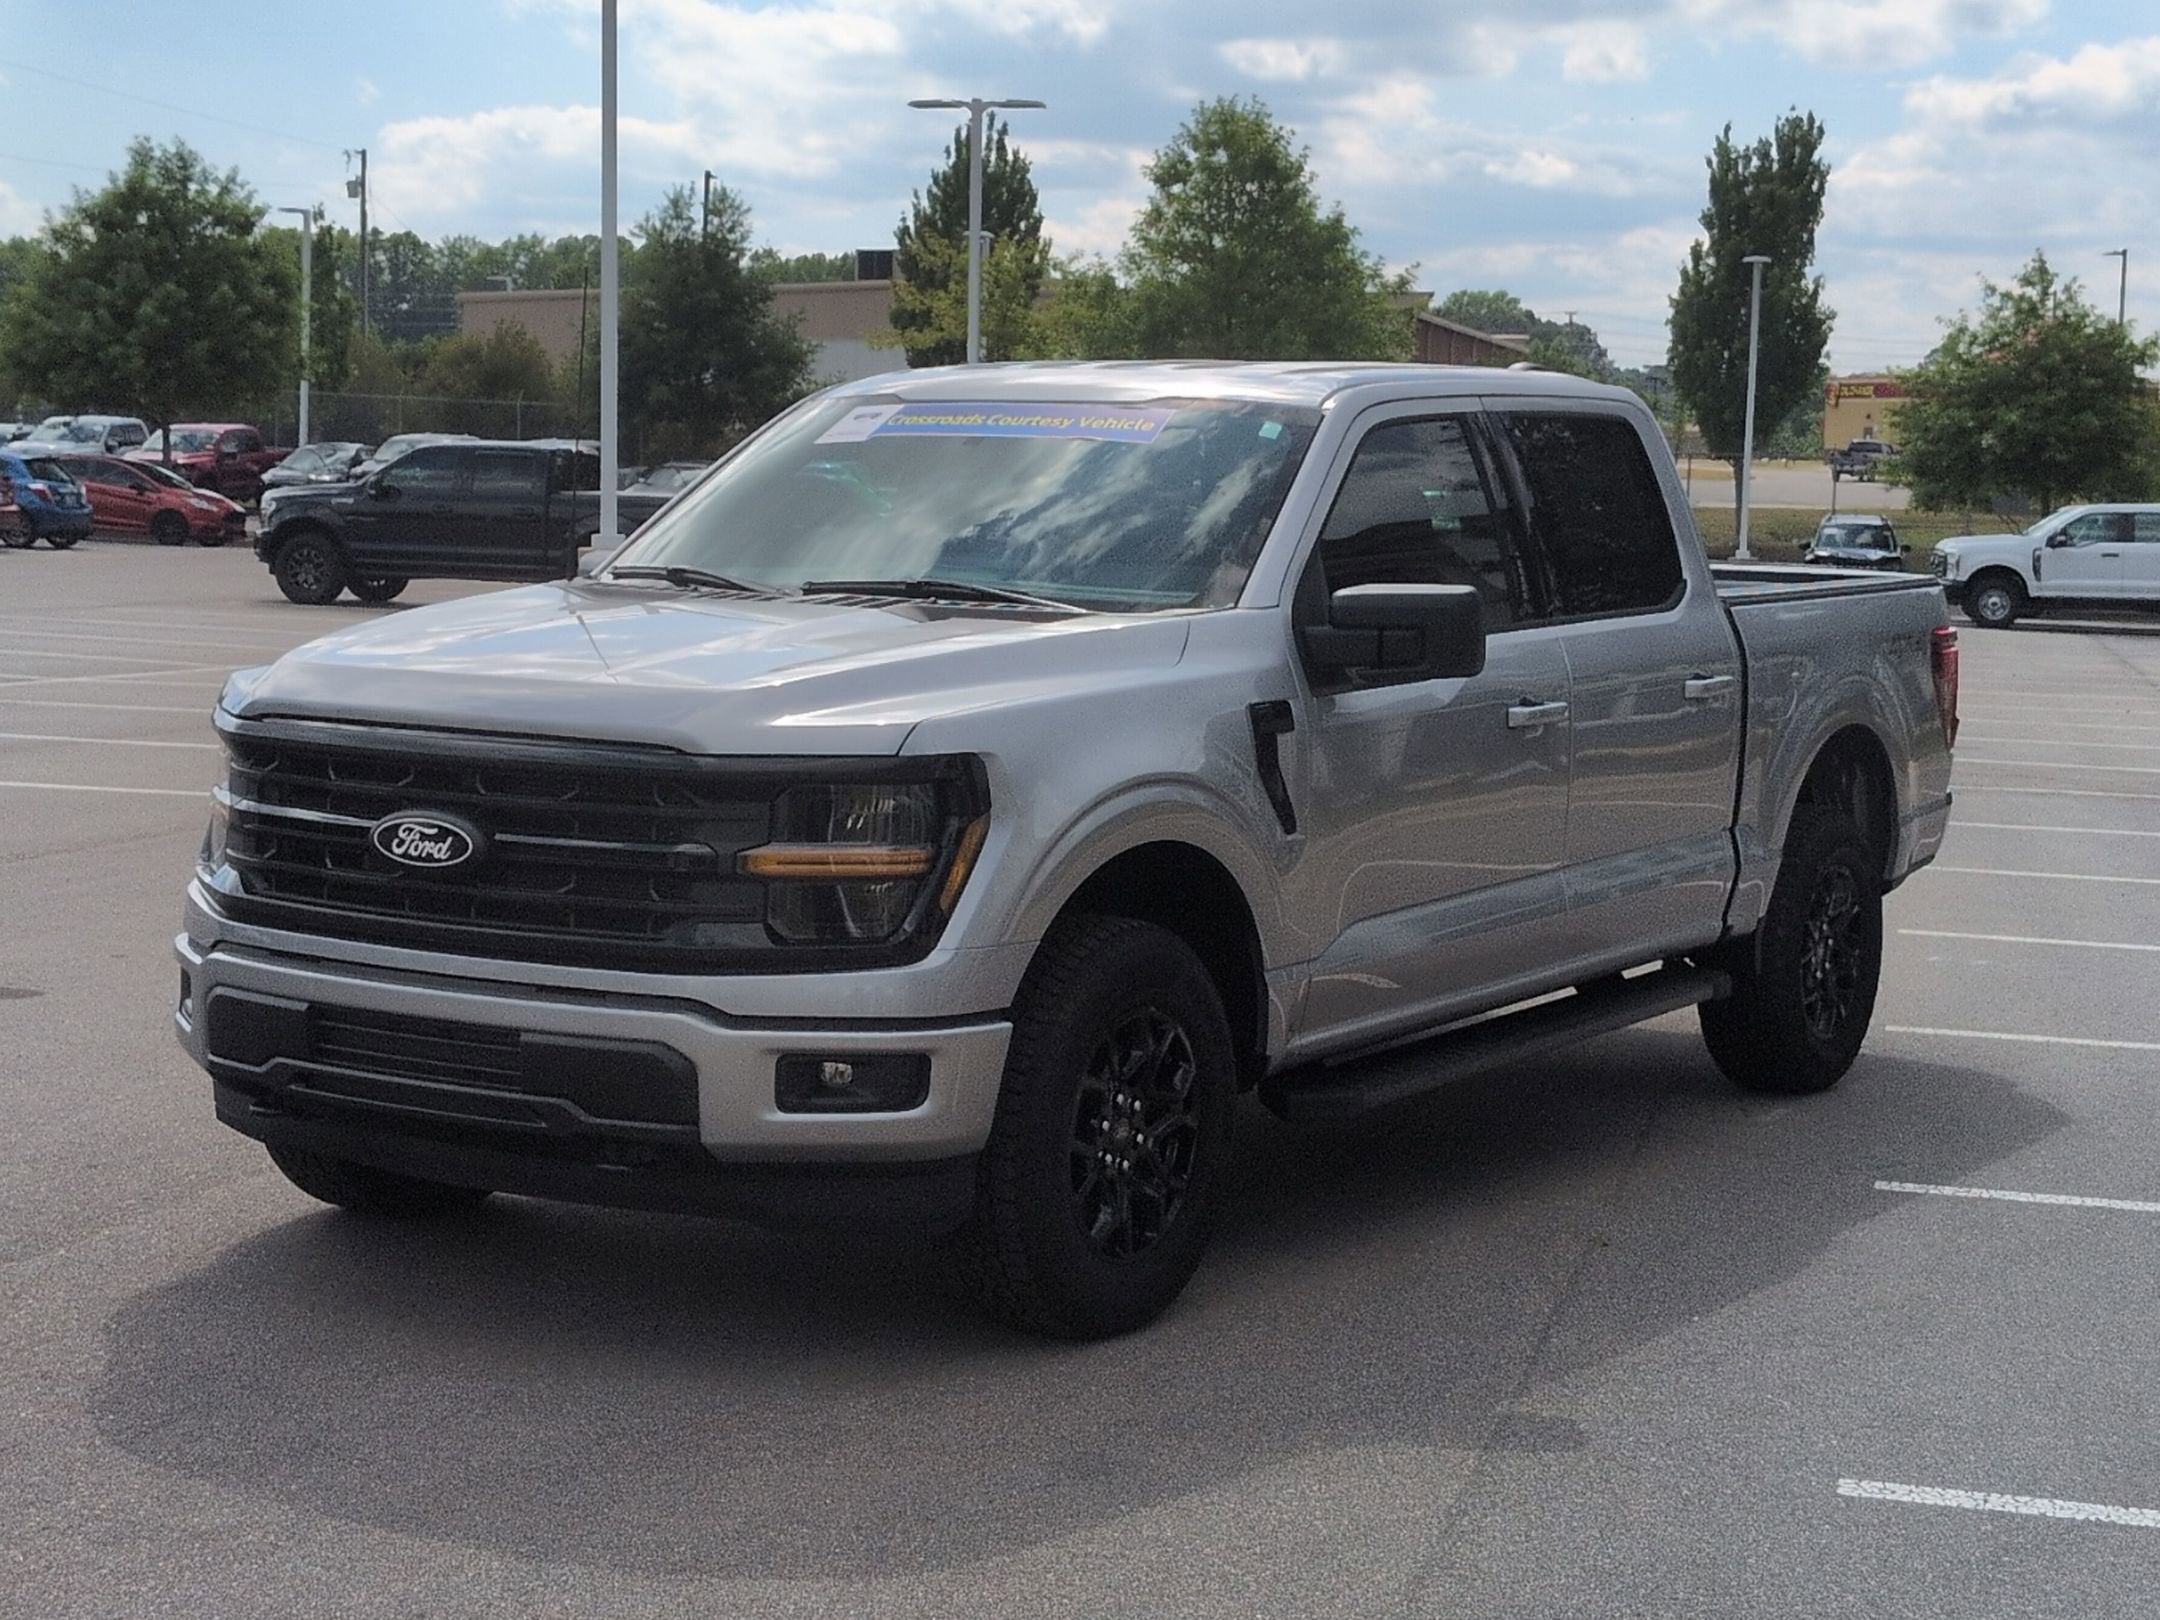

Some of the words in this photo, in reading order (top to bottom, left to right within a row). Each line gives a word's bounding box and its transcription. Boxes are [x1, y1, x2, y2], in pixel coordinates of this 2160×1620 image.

[888, 412, 985, 426] Crossroads
[987, 414, 1075, 428] Courtesy
[1079, 415, 1156, 431] Vehicle
[391, 823, 453, 860] Ford
